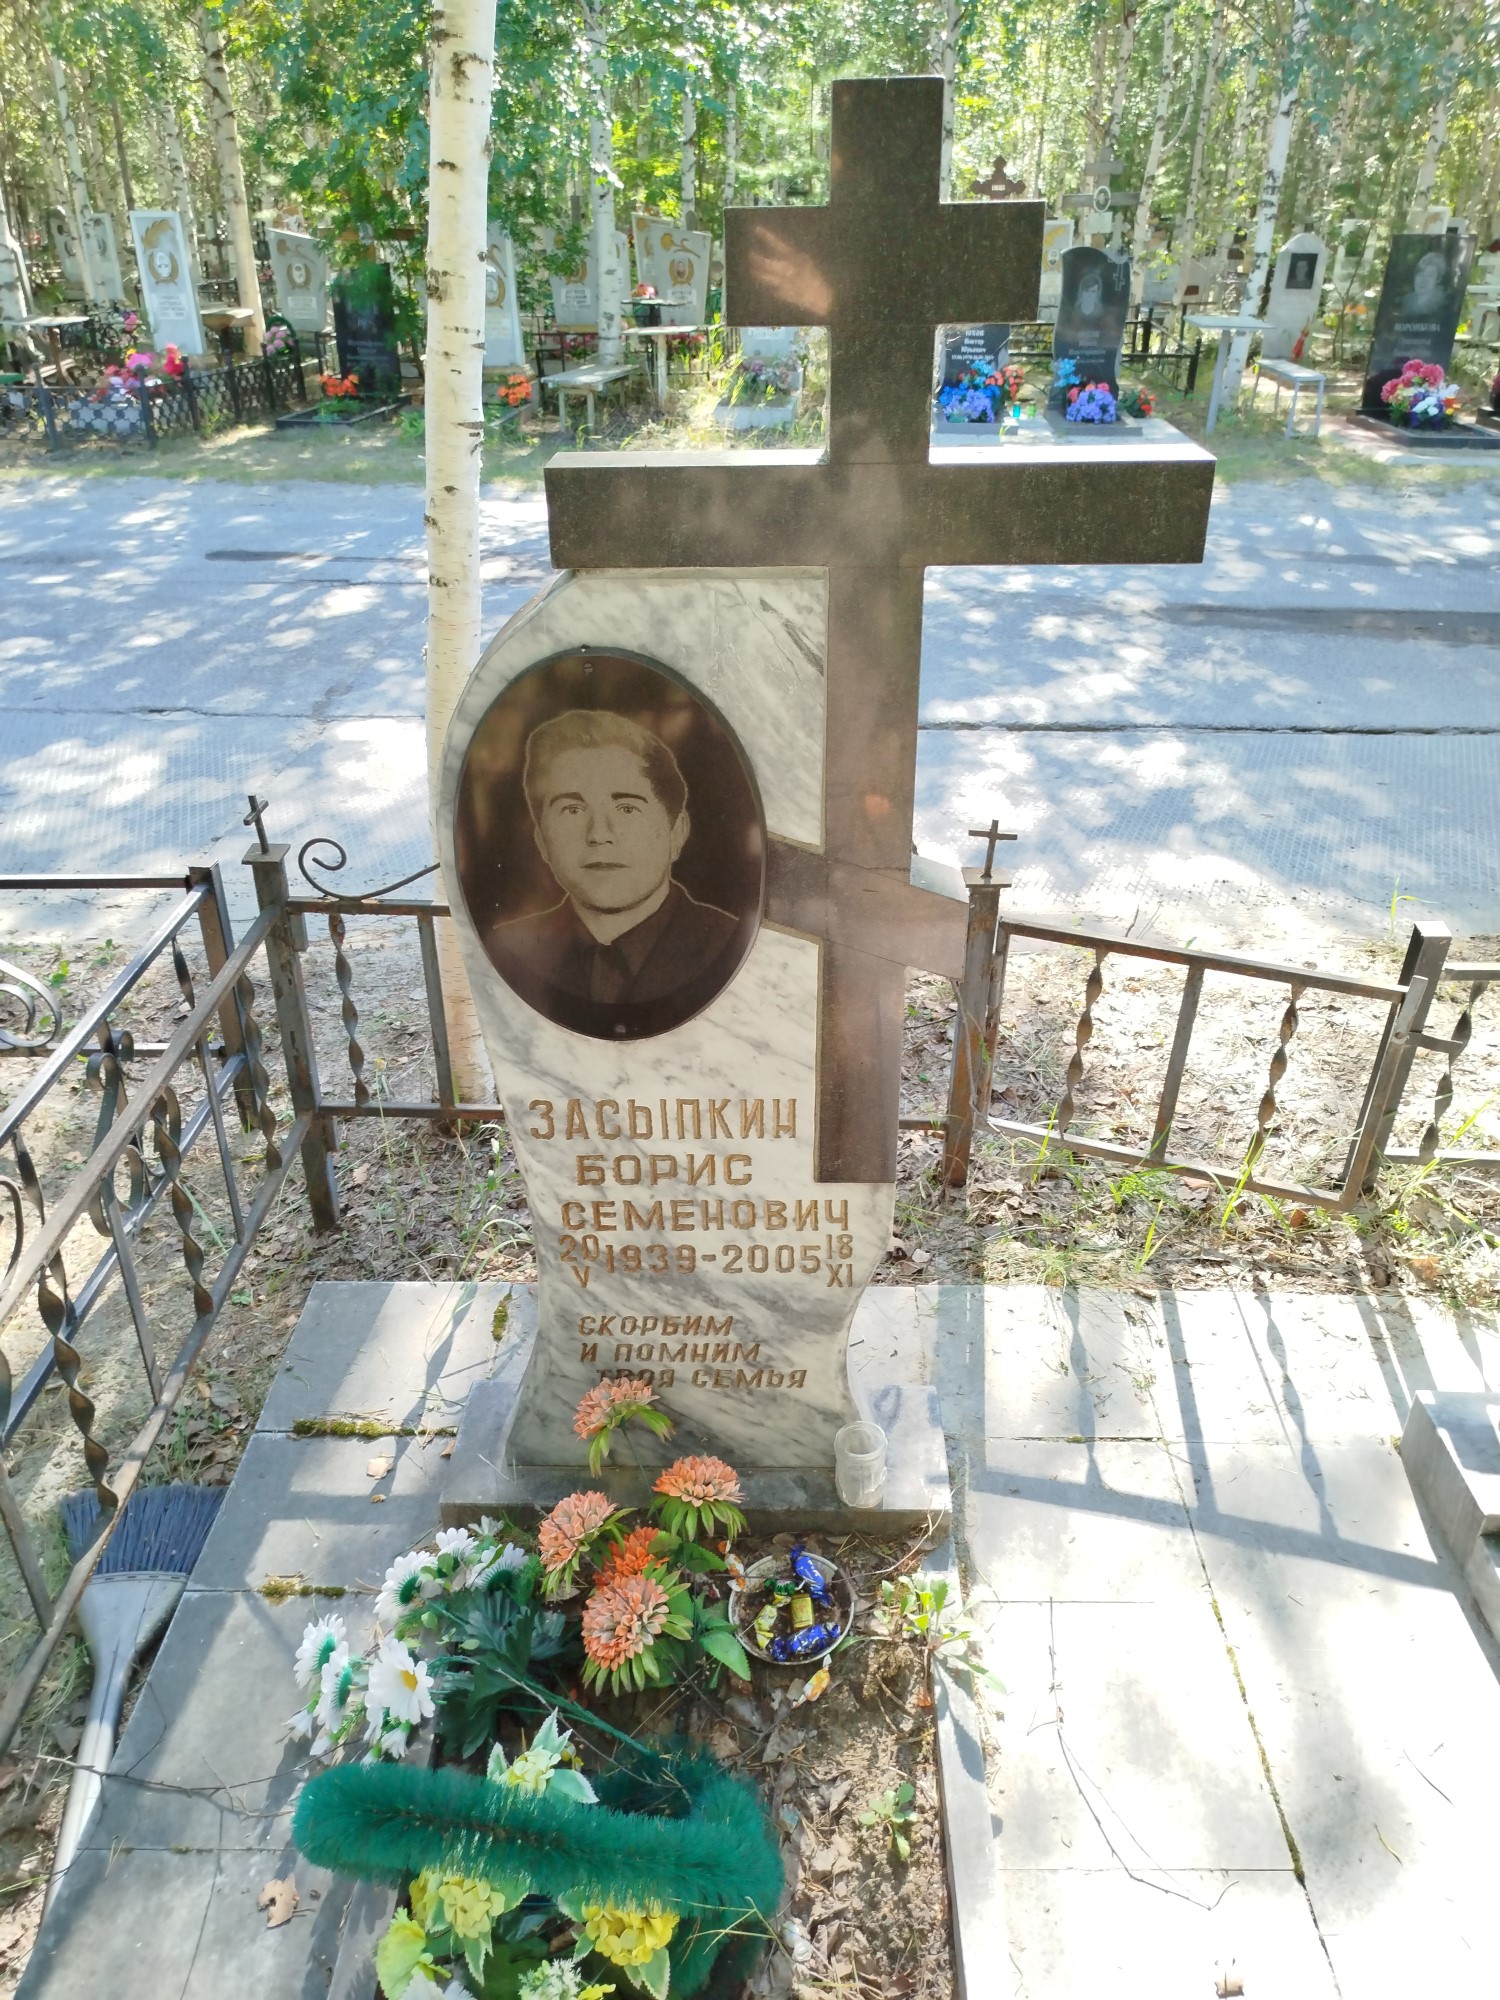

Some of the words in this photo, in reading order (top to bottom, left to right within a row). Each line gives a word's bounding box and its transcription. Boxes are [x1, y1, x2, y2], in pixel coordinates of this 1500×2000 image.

[528, 1098, 797, 1141] ЗАСЫПКИН
[576, 1154, 753, 1186] БОРИС
[561, 1199, 849, 1232] СЕМЕНОВИЧ
[558, 1234, 599, 1262] 20
[605, 1243, 821, 1275] 1939-2005
[826, 1234, 853, 1260] 18
[571, 1265, 590, 1288] V
[578, 1315, 734, 1336] СКОРБИМ
[580, 1342, 597, 1363] И
[614, 1342, 761, 1363] ПОМНИМ
[690, 1368, 808, 1389] СЕМЬЯ
